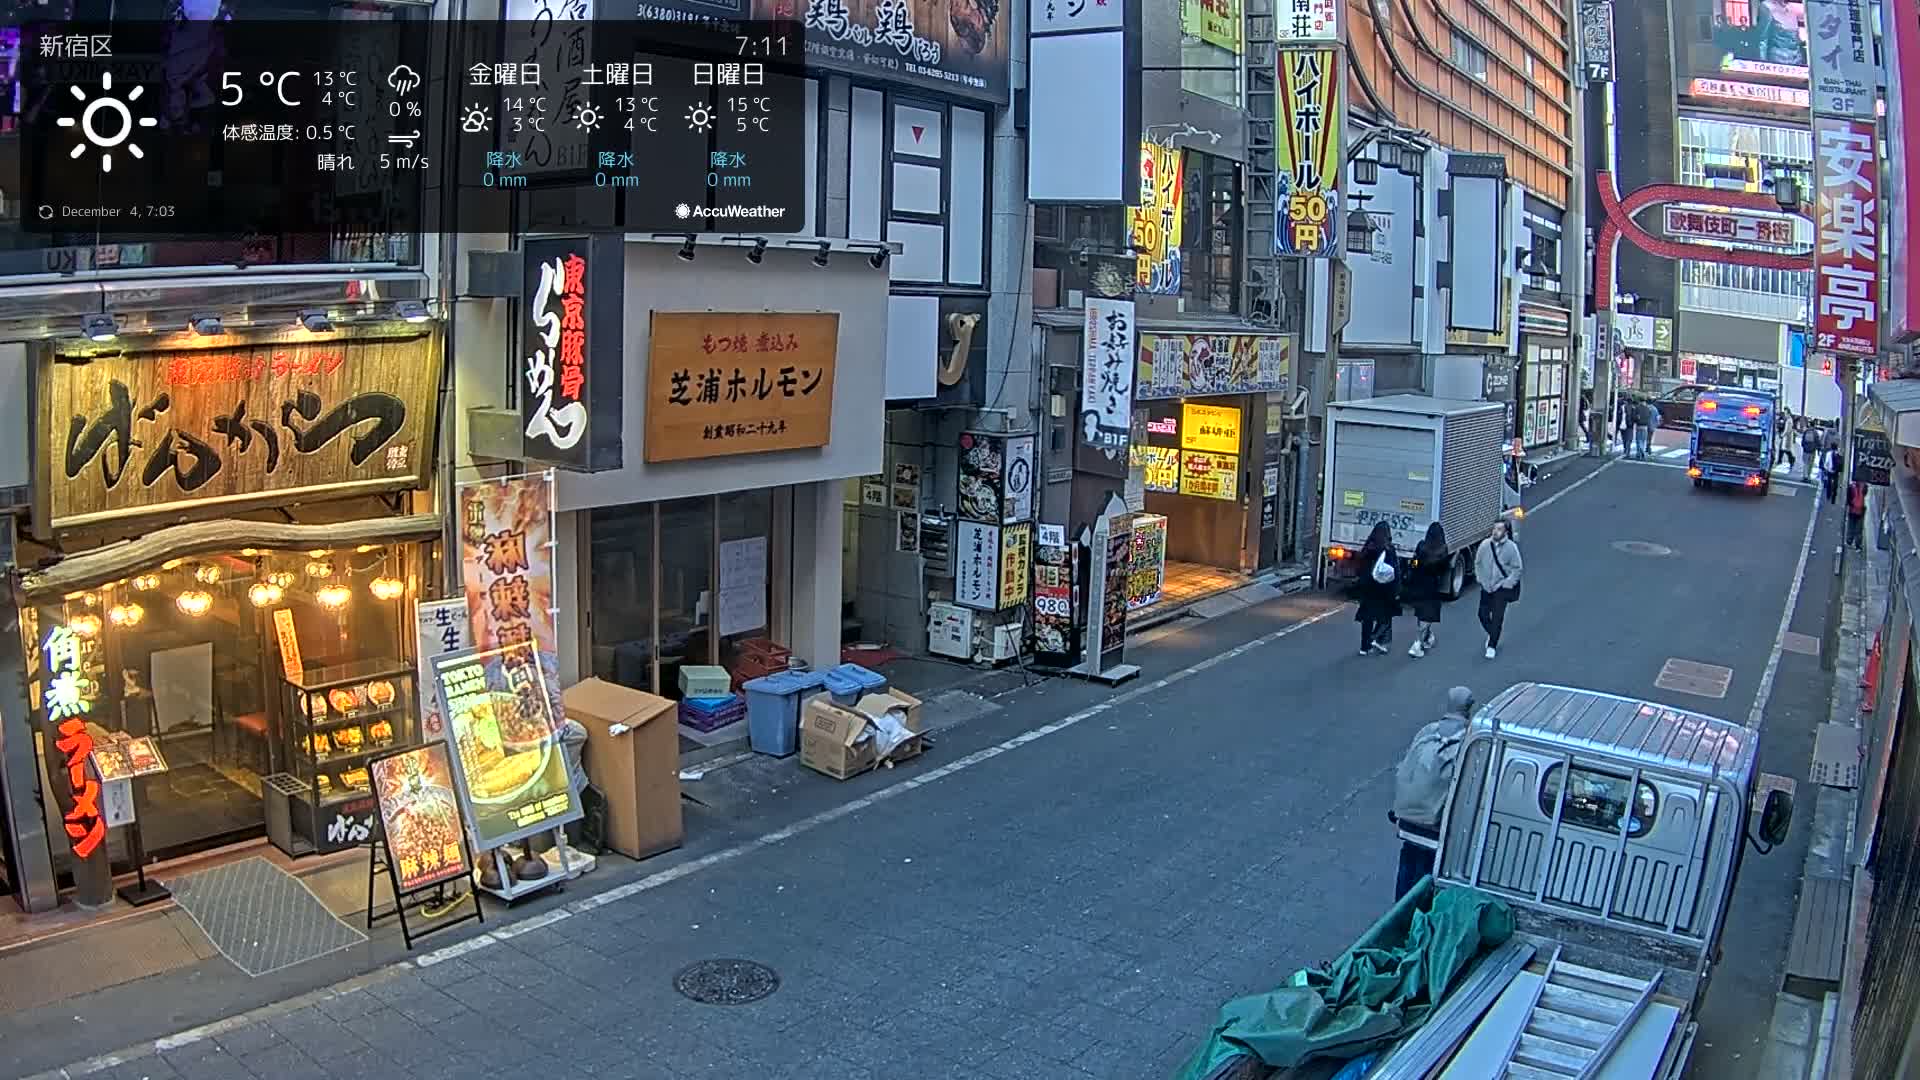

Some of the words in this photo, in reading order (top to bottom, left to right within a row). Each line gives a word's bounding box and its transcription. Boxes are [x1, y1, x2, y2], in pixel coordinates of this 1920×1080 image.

[1588, 64, 1609, 79] 7F
[1832, 96, 1855, 112] 3F
[1293, 52, 1323, 190] ハイボール
[1669, 211, 1793, 244] 歌舞伎町一番街
[1819, 126, 1876, 331] 安楽亭
[560, 253, 587, 402] 東京豚骨
[1817, 332, 1835, 347] 2F
[1100, 309, 1129, 416] お好み焼き
[668, 366, 824, 406] 芝浦ホルモン
[1103, 433, 1128, 447] B1F
[1041, 530, 1060, 544] 4階
[1036, 597, 1067, 614] 980
